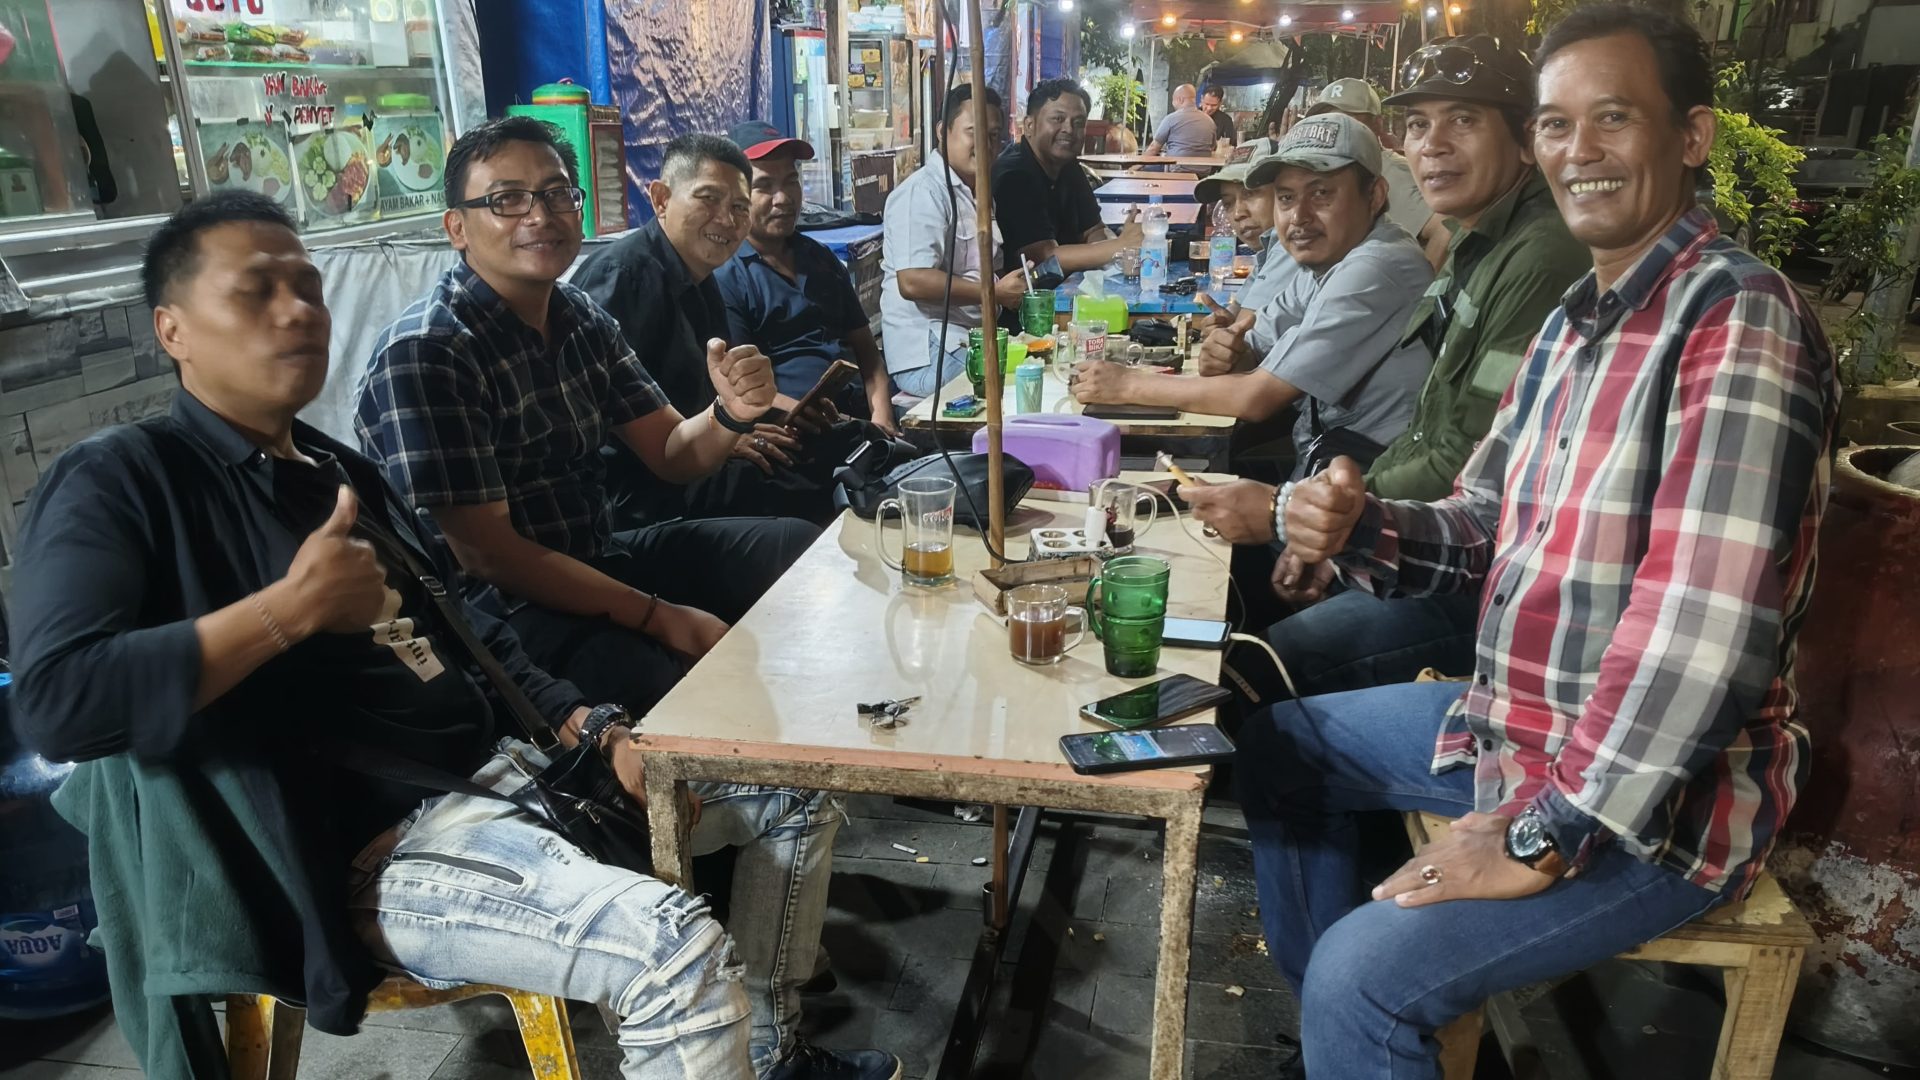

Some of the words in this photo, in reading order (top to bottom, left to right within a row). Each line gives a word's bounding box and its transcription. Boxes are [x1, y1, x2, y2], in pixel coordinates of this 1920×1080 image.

[1330, 84, 1343, 98] R
[381, 197, 399, 212] AYAM
[400, 194, 425, 210] BAKAR
[4, 934, 63, 955] AQUA
